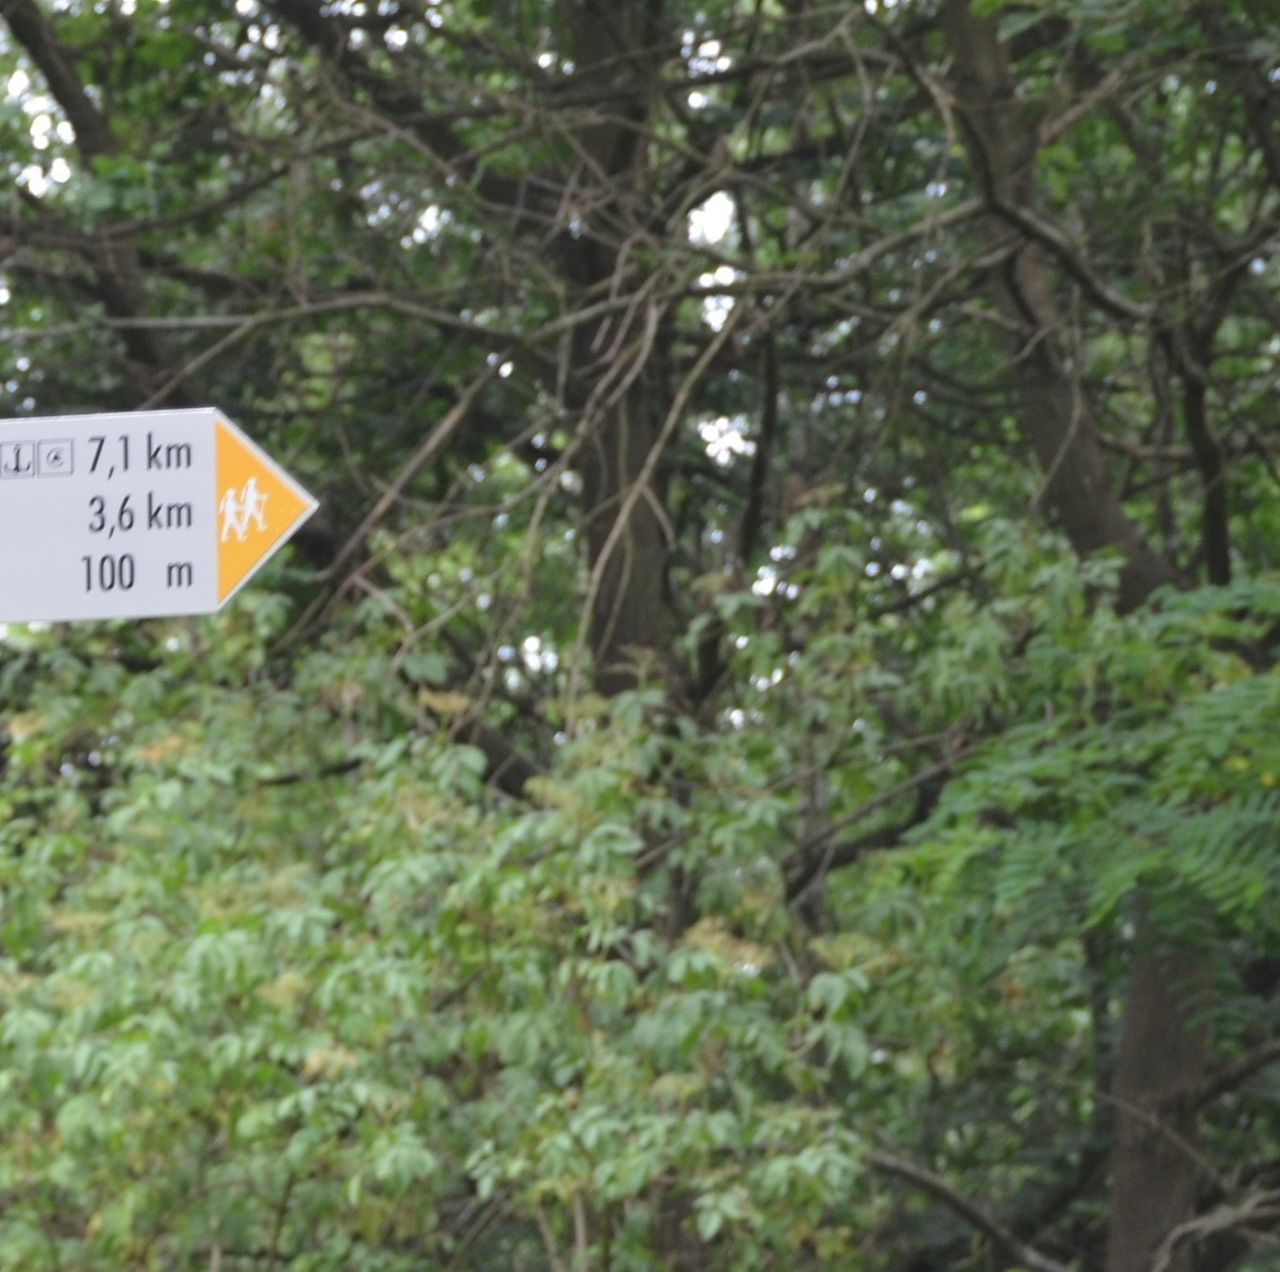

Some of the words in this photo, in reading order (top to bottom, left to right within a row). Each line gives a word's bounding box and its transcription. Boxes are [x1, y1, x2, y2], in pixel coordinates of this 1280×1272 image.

[87, 434, 131, 480] 7,1
[146, 431, 192, 470] km
[88, 495, 135, 539] 3,6
[146, 491, 193, 530] km
[81, 553, 135, 592] 100
[166, 561, 193, 589] m
